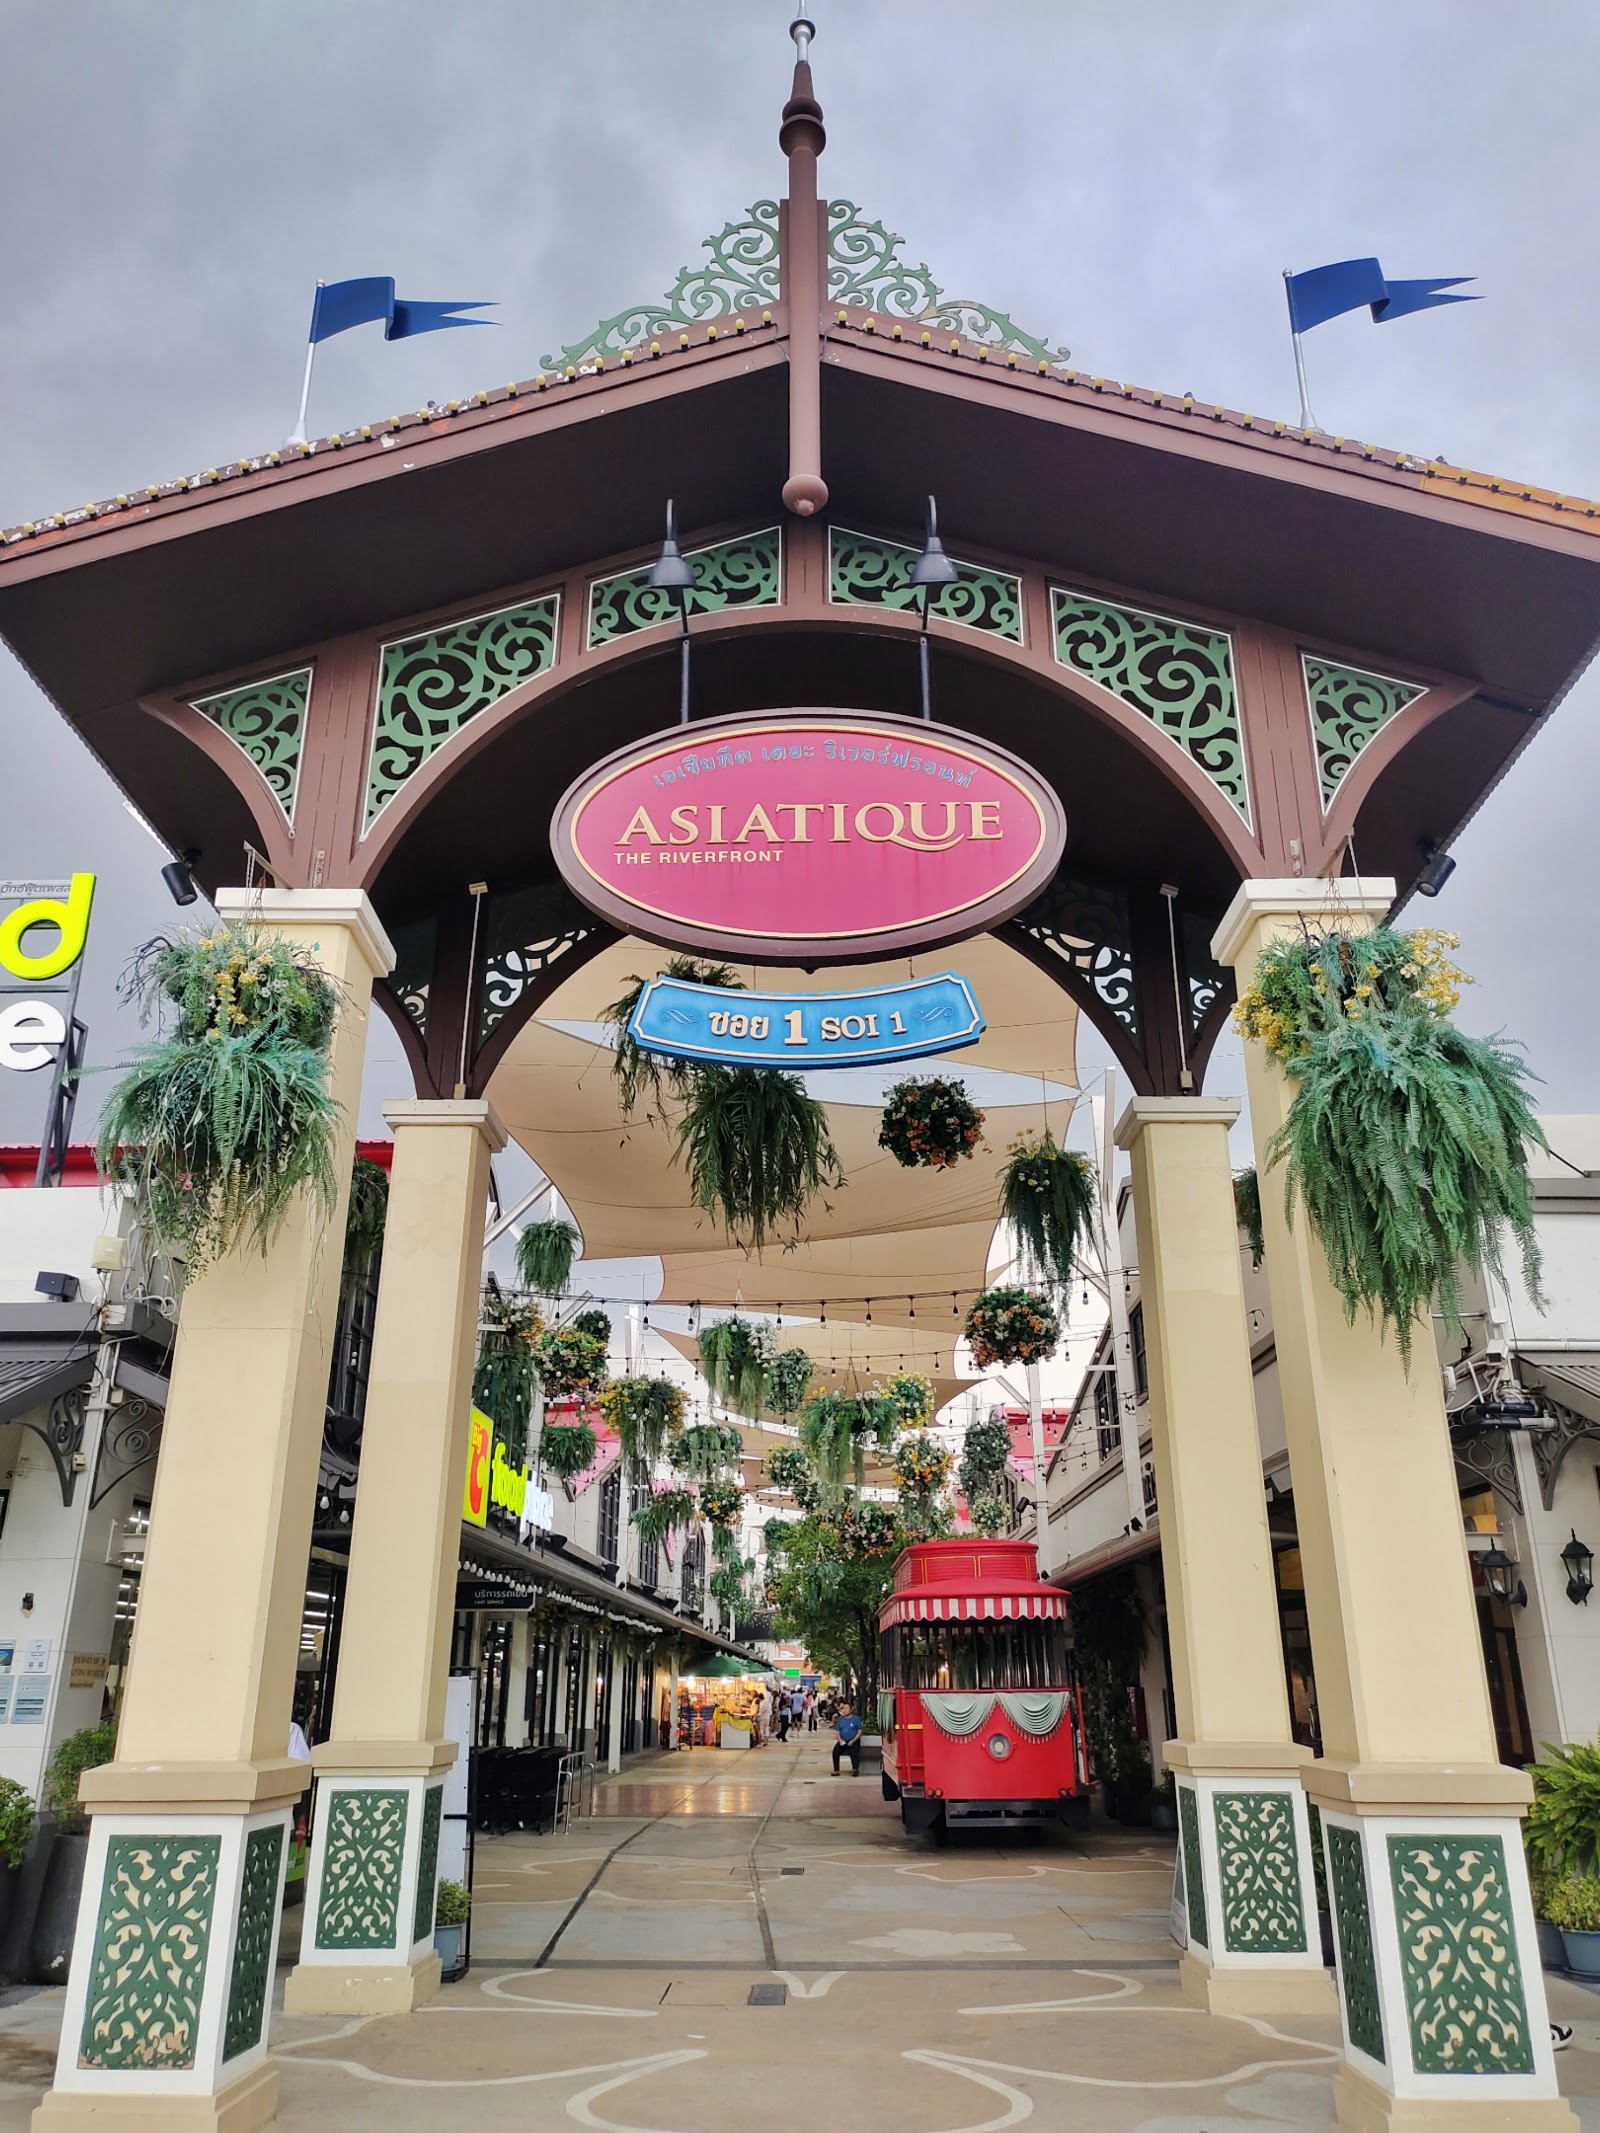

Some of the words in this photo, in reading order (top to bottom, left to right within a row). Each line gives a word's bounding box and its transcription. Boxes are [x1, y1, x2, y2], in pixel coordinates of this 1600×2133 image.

[762, 745, 815, 761] เดอะ
[614, 800, 1004, 852] ASIATIQUE
[614, 852, 652, 865] THE
[659, 850, 784, 864] RIVERFRONT
[709, 1011, 770, 1040] ซอย
[784, 1010, 808, 1046] 1
[821, 1013, 880, 1041] SOI
[890, 1010, 908, 1035] 1
[491, 1442, 528, 1517] food
